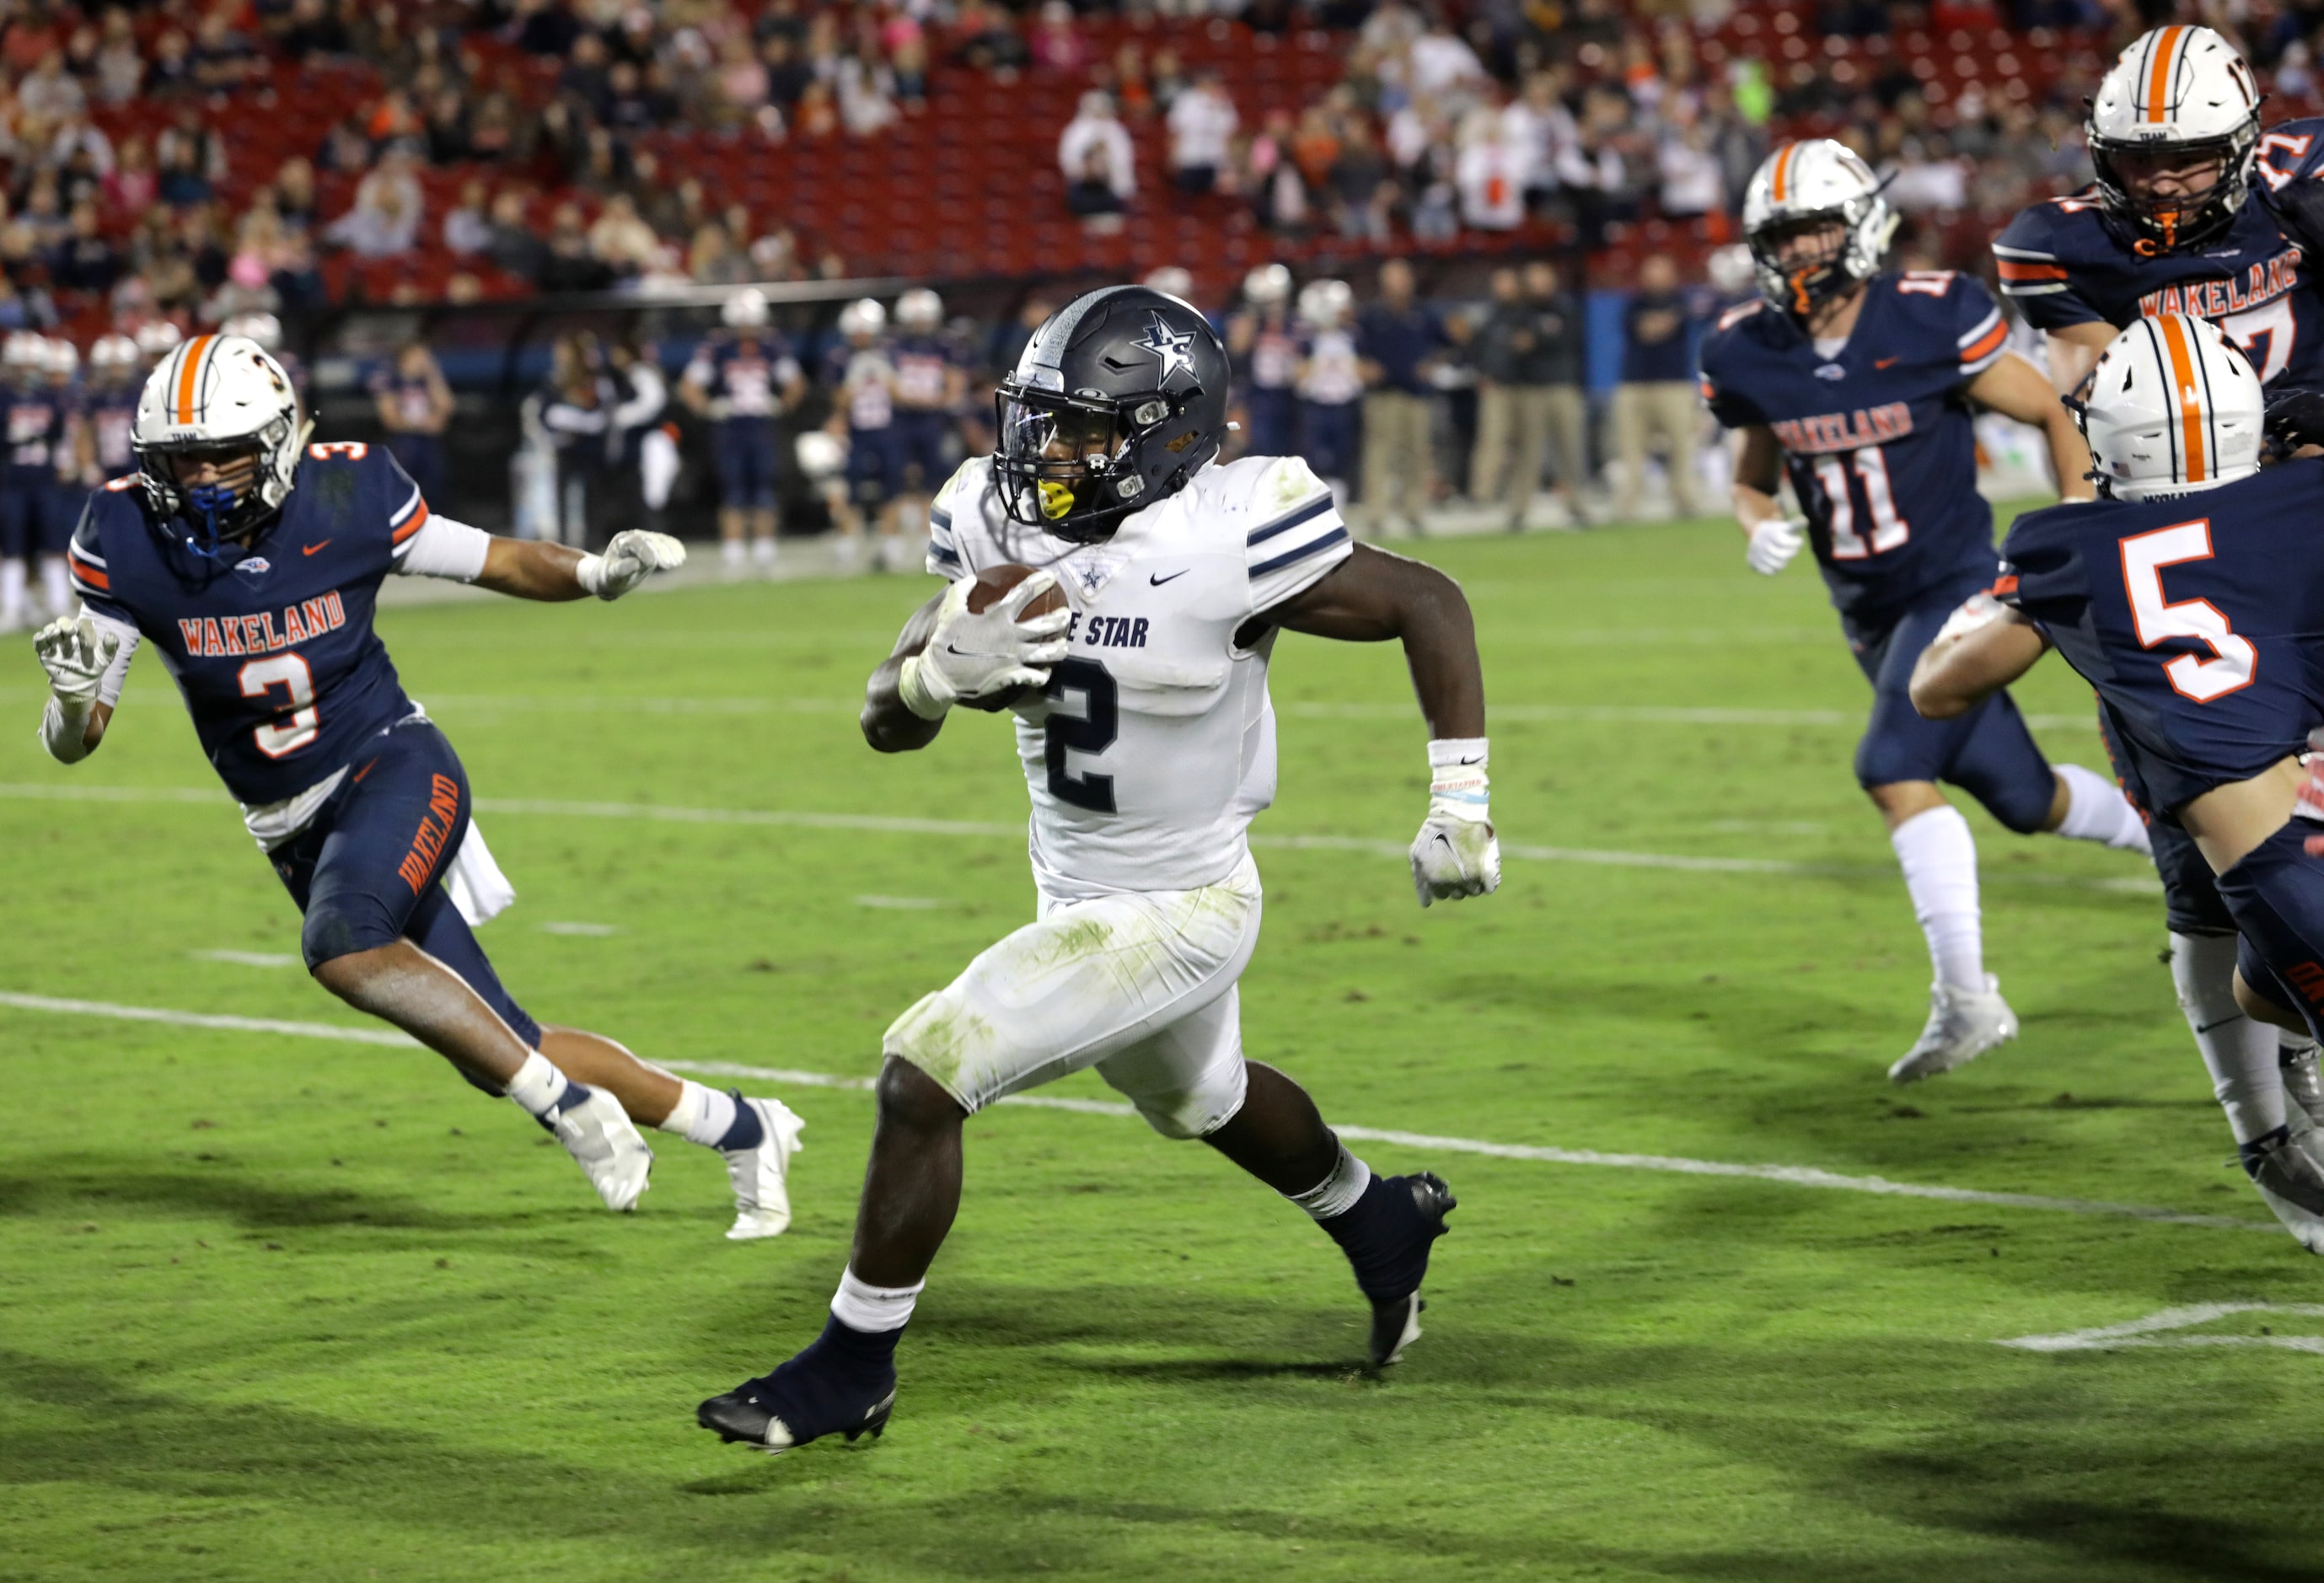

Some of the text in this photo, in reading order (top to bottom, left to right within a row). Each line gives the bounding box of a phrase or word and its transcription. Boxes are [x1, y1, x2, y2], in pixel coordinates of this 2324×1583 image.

[2138, 247, 2302, 319] WAKELAND
[1813, 444, 1910, 561] 11
[178, 589, 346, 657] WAKELAND
[1085, 615, 1150, 648] STAR
[2117, 517, 2259, 706] 5
[236, 649, 321, 758] 3
[1044, 654, 1119, 815] 2
[398, 772, 459, 898] WAKELAND
